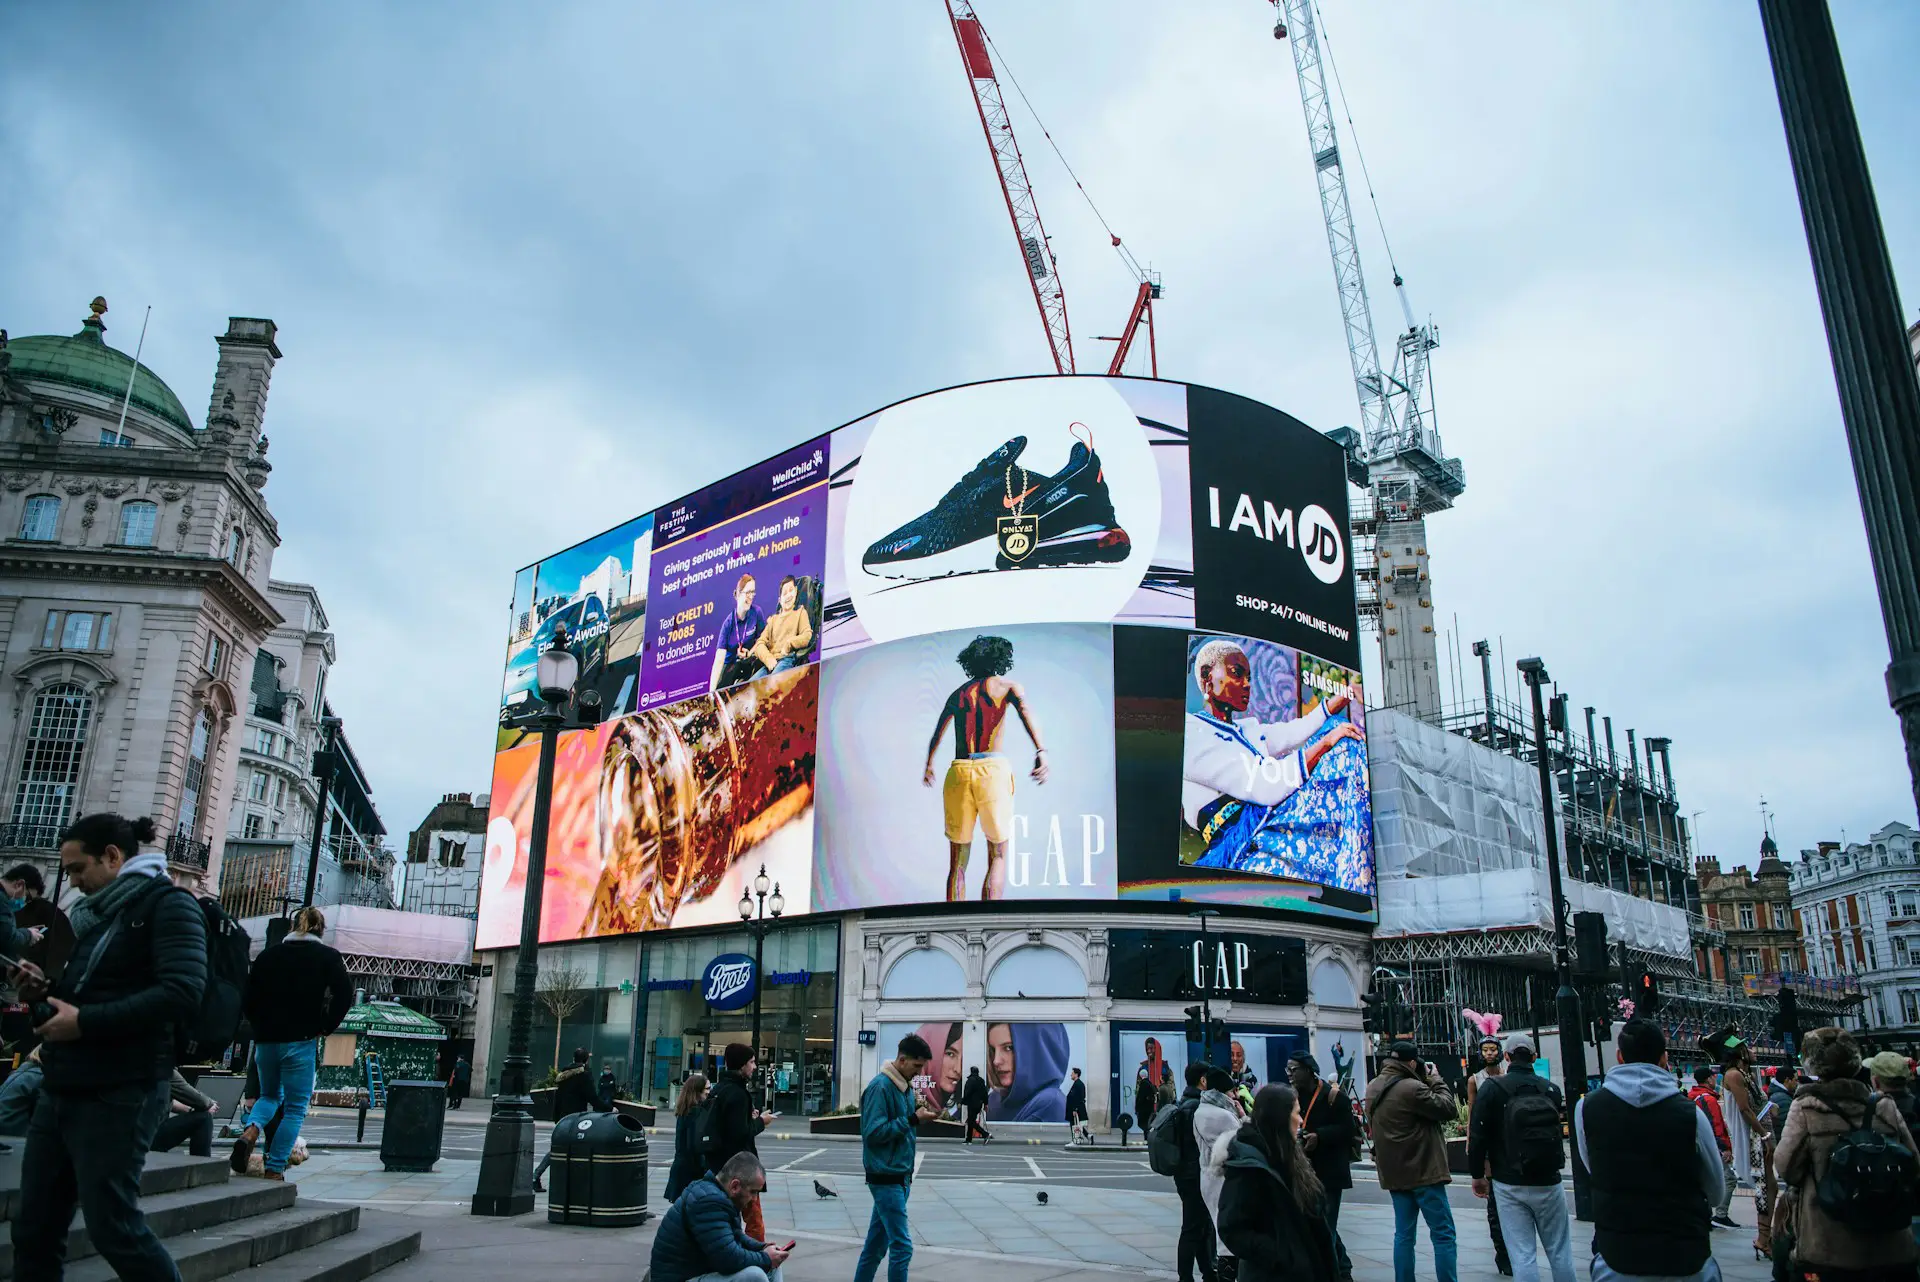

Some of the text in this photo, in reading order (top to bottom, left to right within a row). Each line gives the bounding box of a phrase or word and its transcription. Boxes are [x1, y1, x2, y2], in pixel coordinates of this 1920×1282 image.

[1025, 240, 1045, 278] WOLFF
[772, 459, 813, 486] WellChild
[671, 506, 686, 519] THE
[1208, 486, 1221, 529] I
[1228, 493, 1295, 550] AM
[663, 516, 801, 577] Giving seriously ill children the
[662, 535, 803, 595] best chance to thrive. At home.
[659, 601, 714, 631] Text CHELT 10
[1235, 594, 1349, 642] SHOP 24/7 ONLINE NOW
[573, 621, 609, 648] Awaits
[657, 624, 695, 648] to 70085
[656, 650, 665, 664] to
[665, 641, 694, 661] donate
[1302, 669, 1355, 701] SAMSUNG
[1007, 814, 1105, 888] GAP
[704, 962, 751, 1001] Boots
[771, 968, 811, 988] beauty
[1193, 939, 1249, 990] GAP
